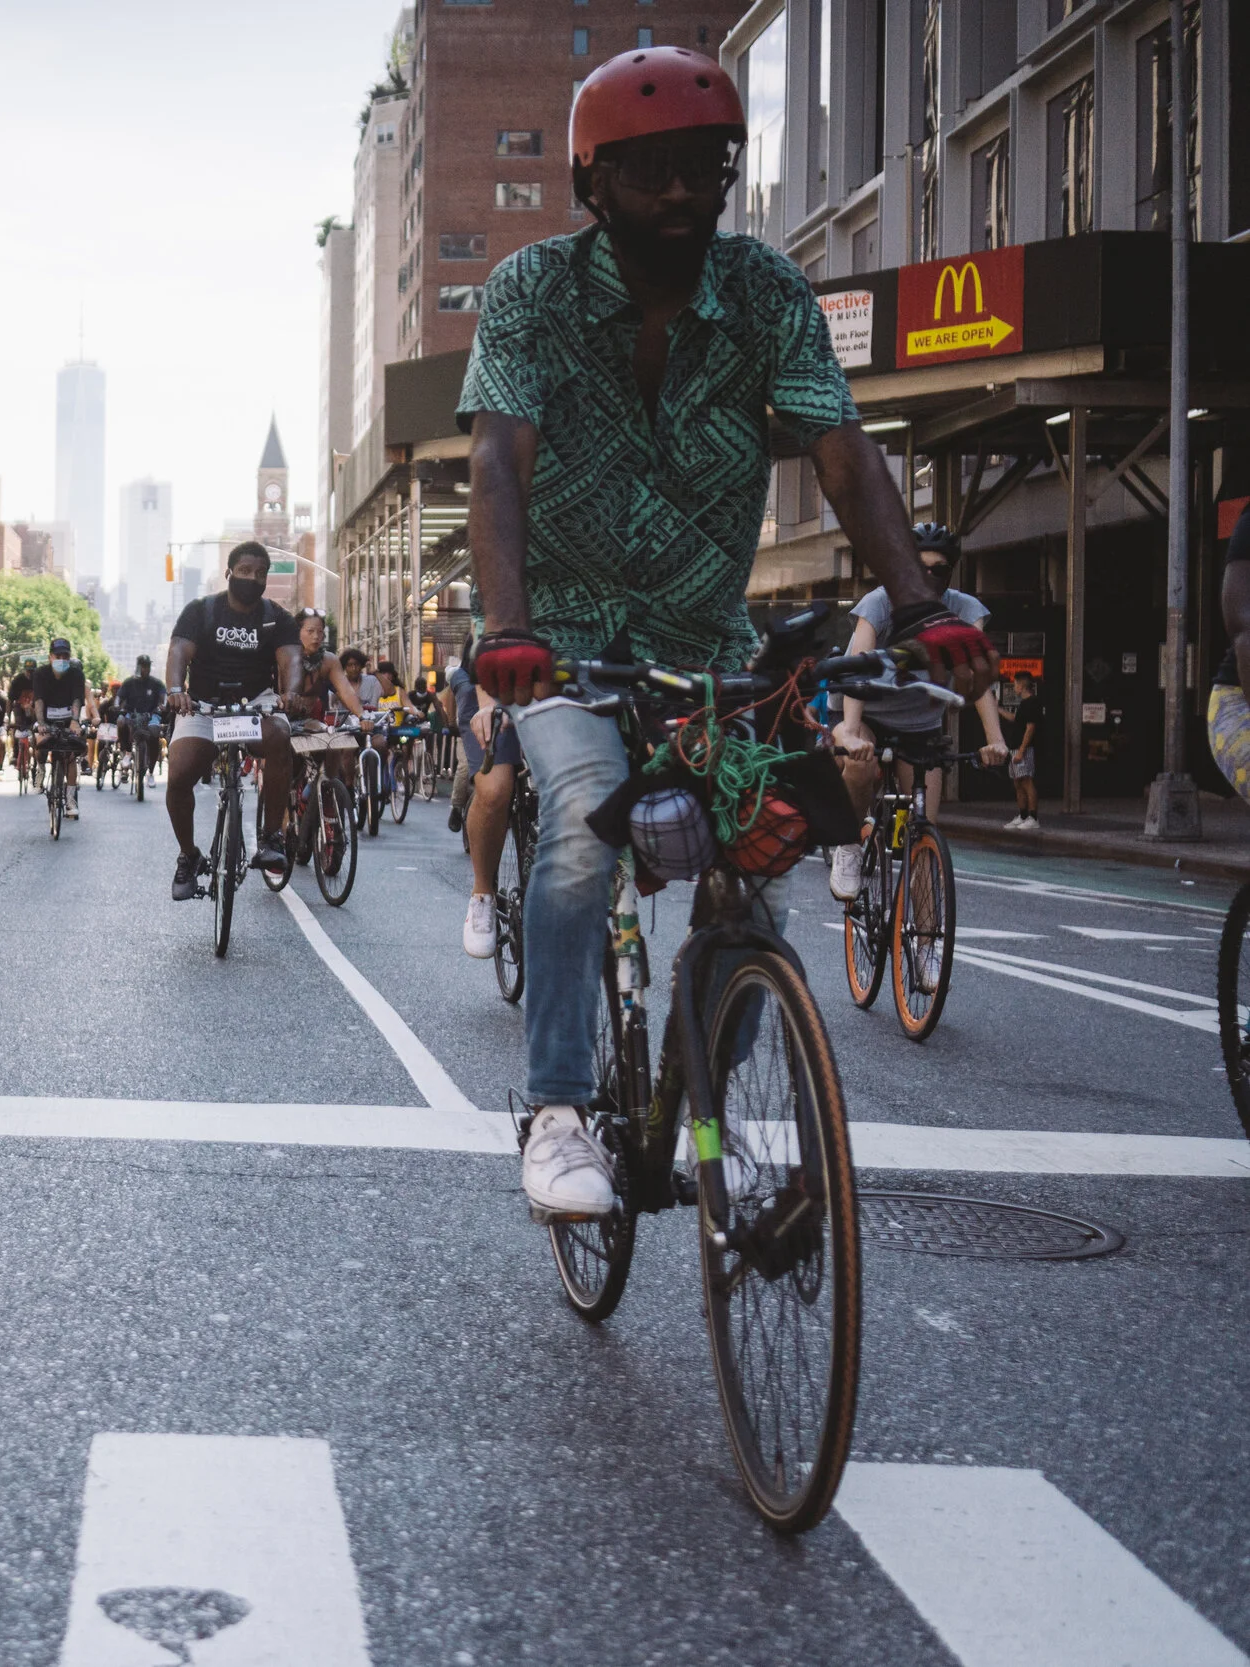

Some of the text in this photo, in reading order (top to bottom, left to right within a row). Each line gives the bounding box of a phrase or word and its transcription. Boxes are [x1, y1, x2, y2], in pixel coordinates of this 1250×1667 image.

[819, 292, 871, 313] llective
[837, 308, 869, 321] MUSIC
[850, 329, 870, 339] Floor
[914, 326, 994, 349] WE ARE OPEN
[834, 341, 868, 353] tive.edu
[225, 640, 259, 650] company
[217, 730, 238, 739] VANESSA
